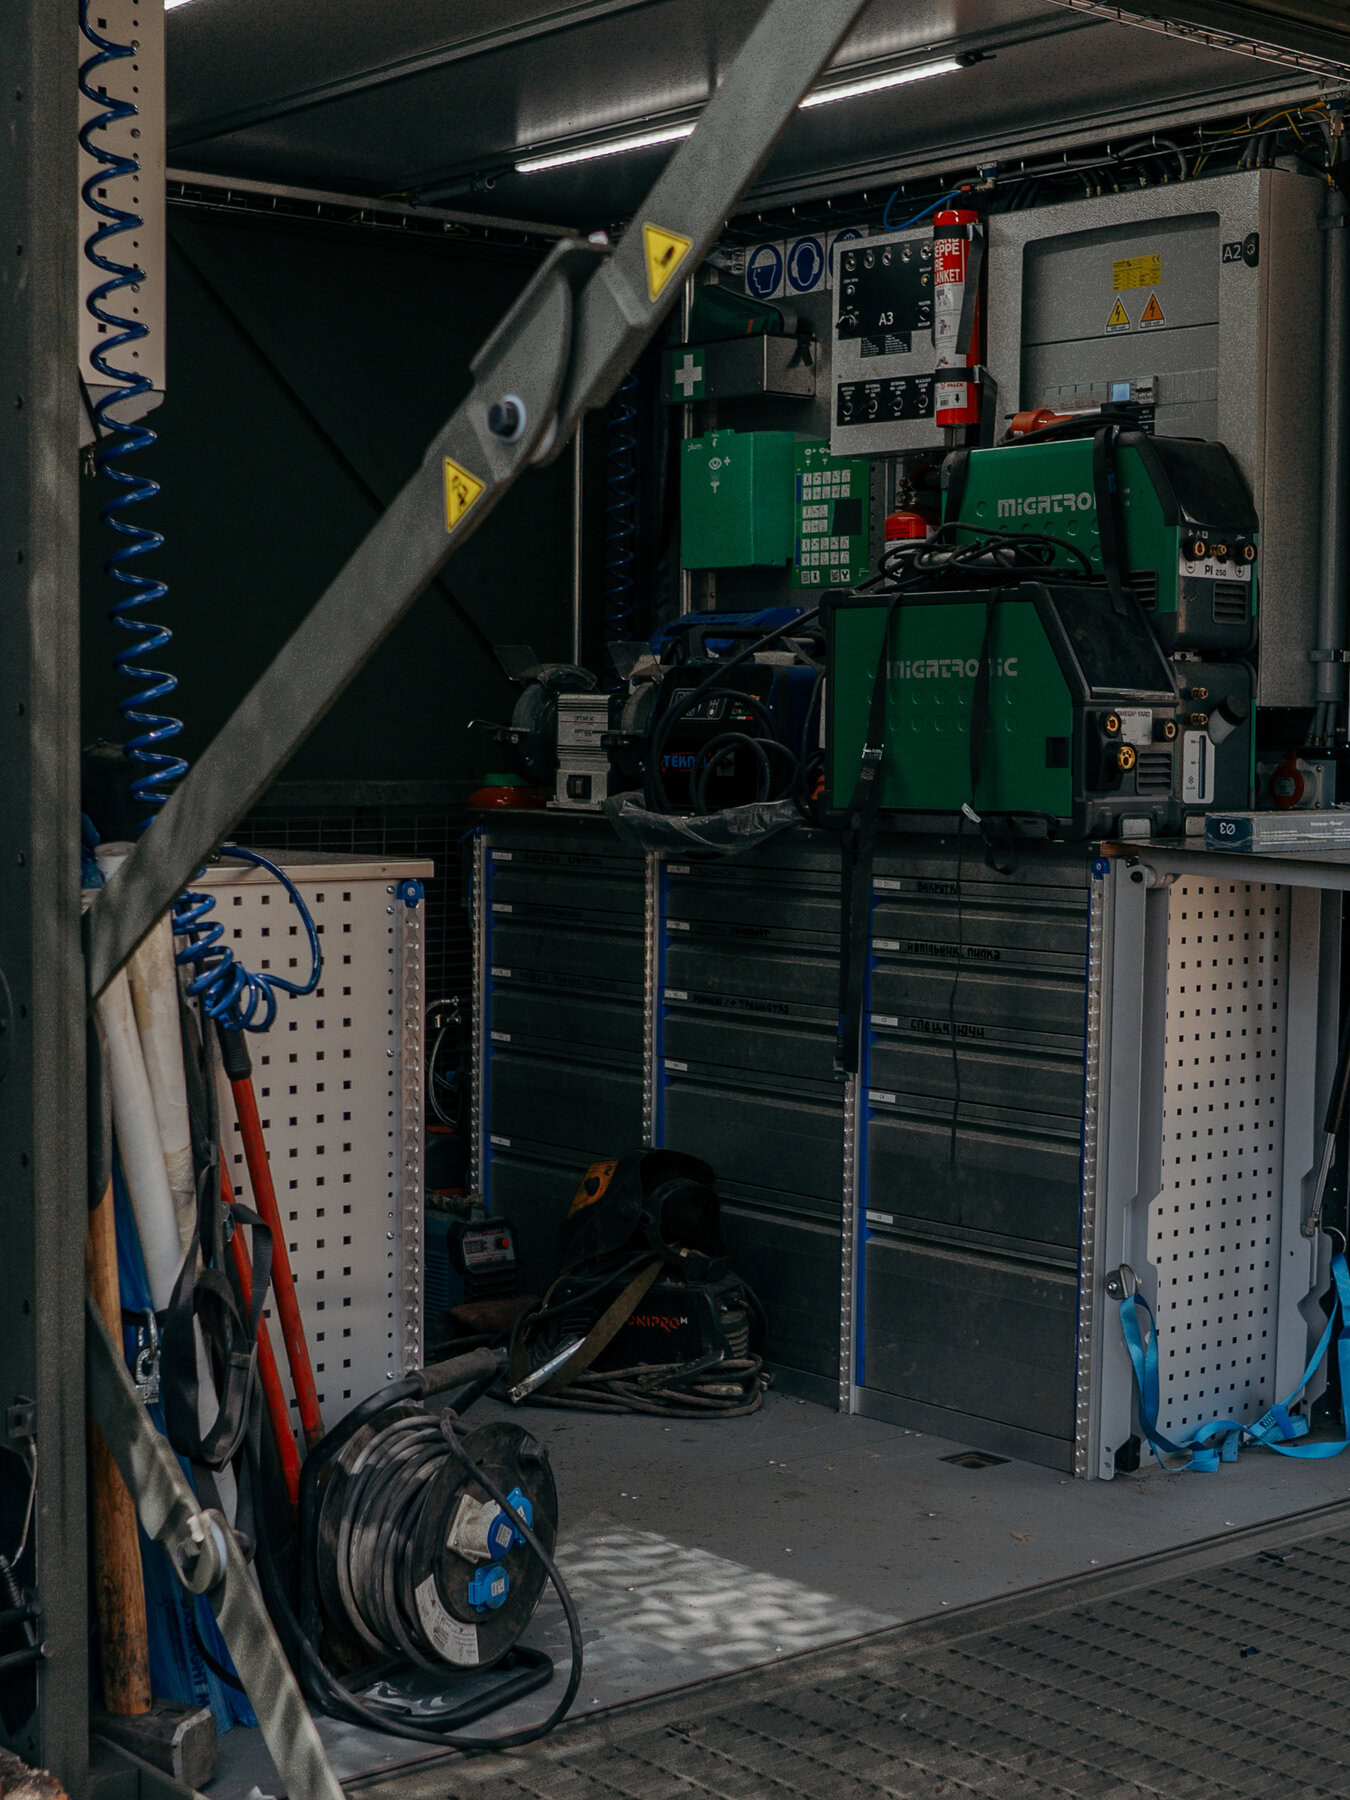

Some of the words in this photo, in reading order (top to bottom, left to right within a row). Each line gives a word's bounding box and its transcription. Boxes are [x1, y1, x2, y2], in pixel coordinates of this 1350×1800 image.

[1223, 246, 1241, 261] A2
[878, 311, 895, 327] A3
[1205, 565, 1213, 575] PI
[1215, 569, 1227, 577] 250
